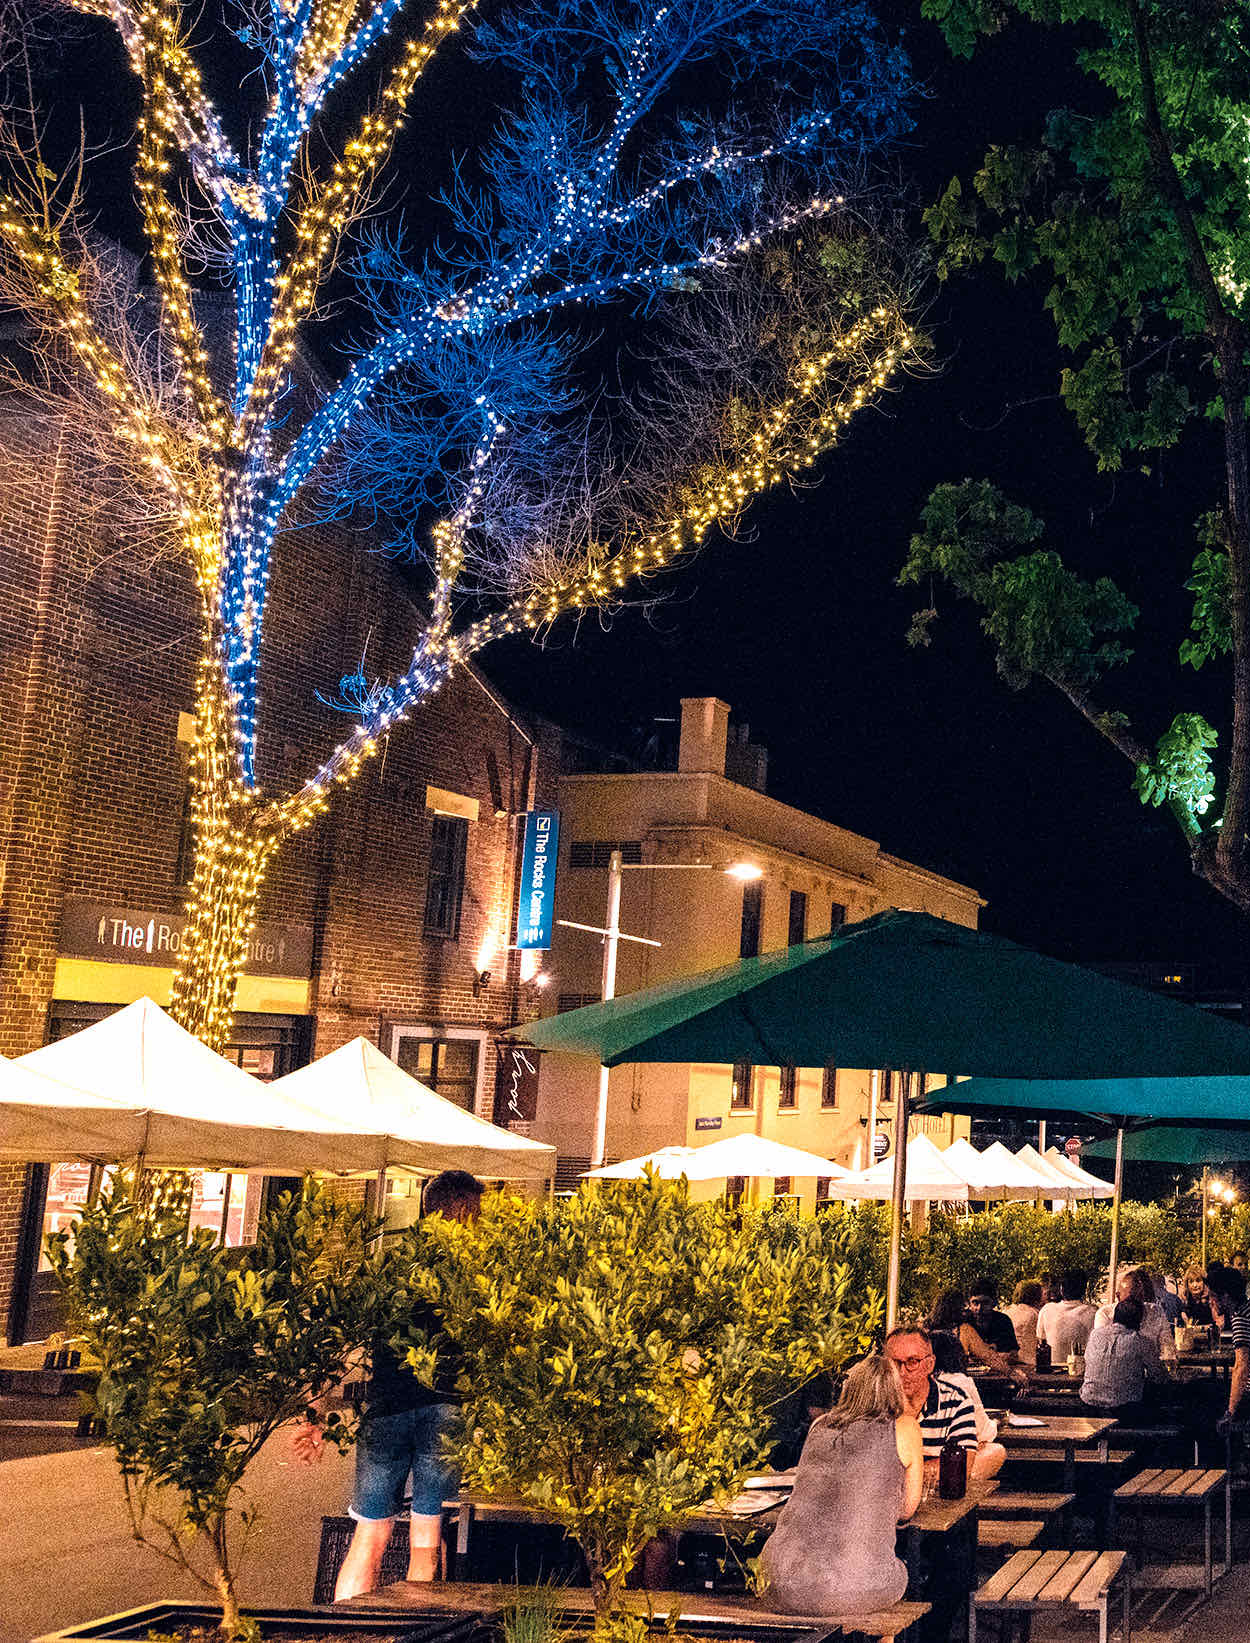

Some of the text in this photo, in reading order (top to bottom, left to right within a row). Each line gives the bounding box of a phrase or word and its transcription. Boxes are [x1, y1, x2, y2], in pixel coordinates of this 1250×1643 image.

[528, 832, 550, 926] The Rocks Centre
[109, 917, 144, 949] The
[248, 939, 276, 964] ntre
[507, 1050, 537, 1119] pony
